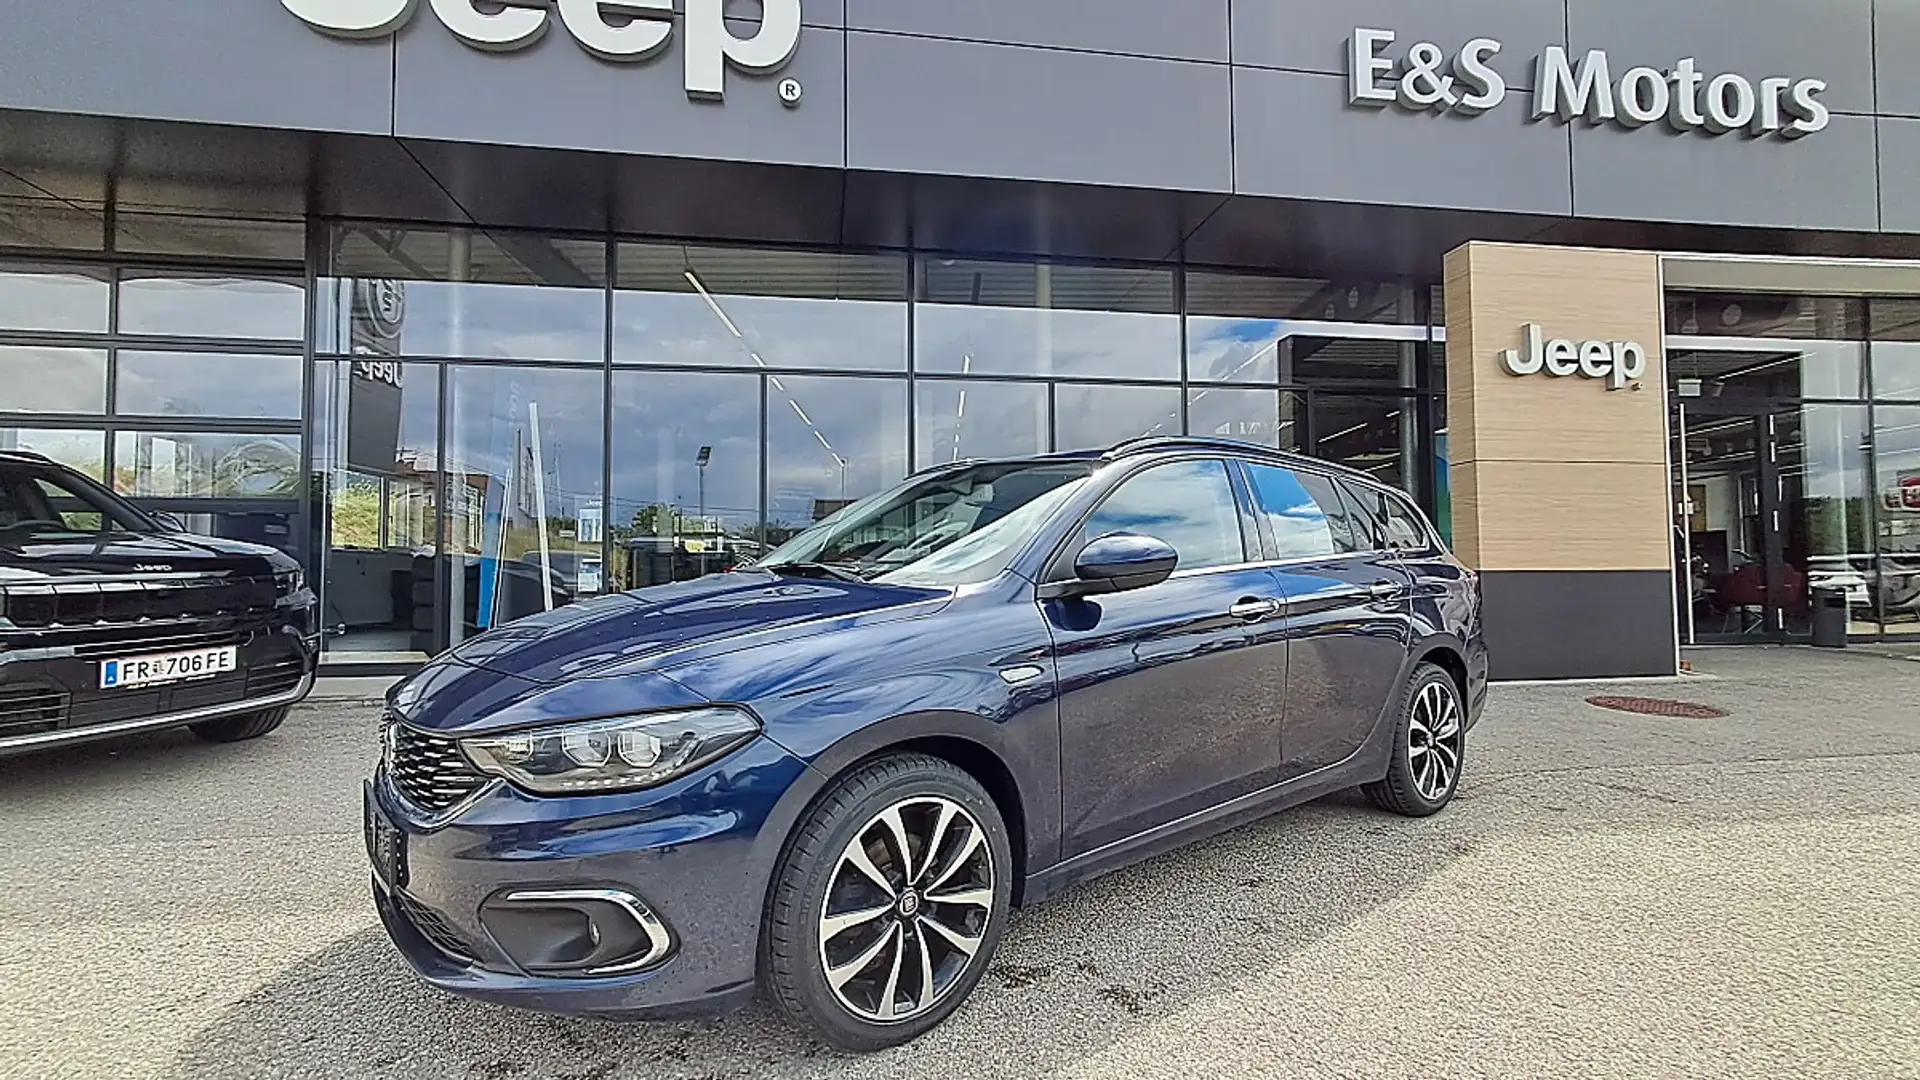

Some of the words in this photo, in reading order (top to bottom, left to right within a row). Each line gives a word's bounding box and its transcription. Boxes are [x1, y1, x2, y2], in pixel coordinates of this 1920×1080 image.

[281, 0, 802, 101] ep
[1350, 27, 1505, 113] E&S
[1532, 45, 1829, 138] Motors
[1499, 322, 1646, 391] Jeep
[123, 661, 149, 681] FR
[166, 655, 202, 675] 706
[206, 651, 229, 669] FE
